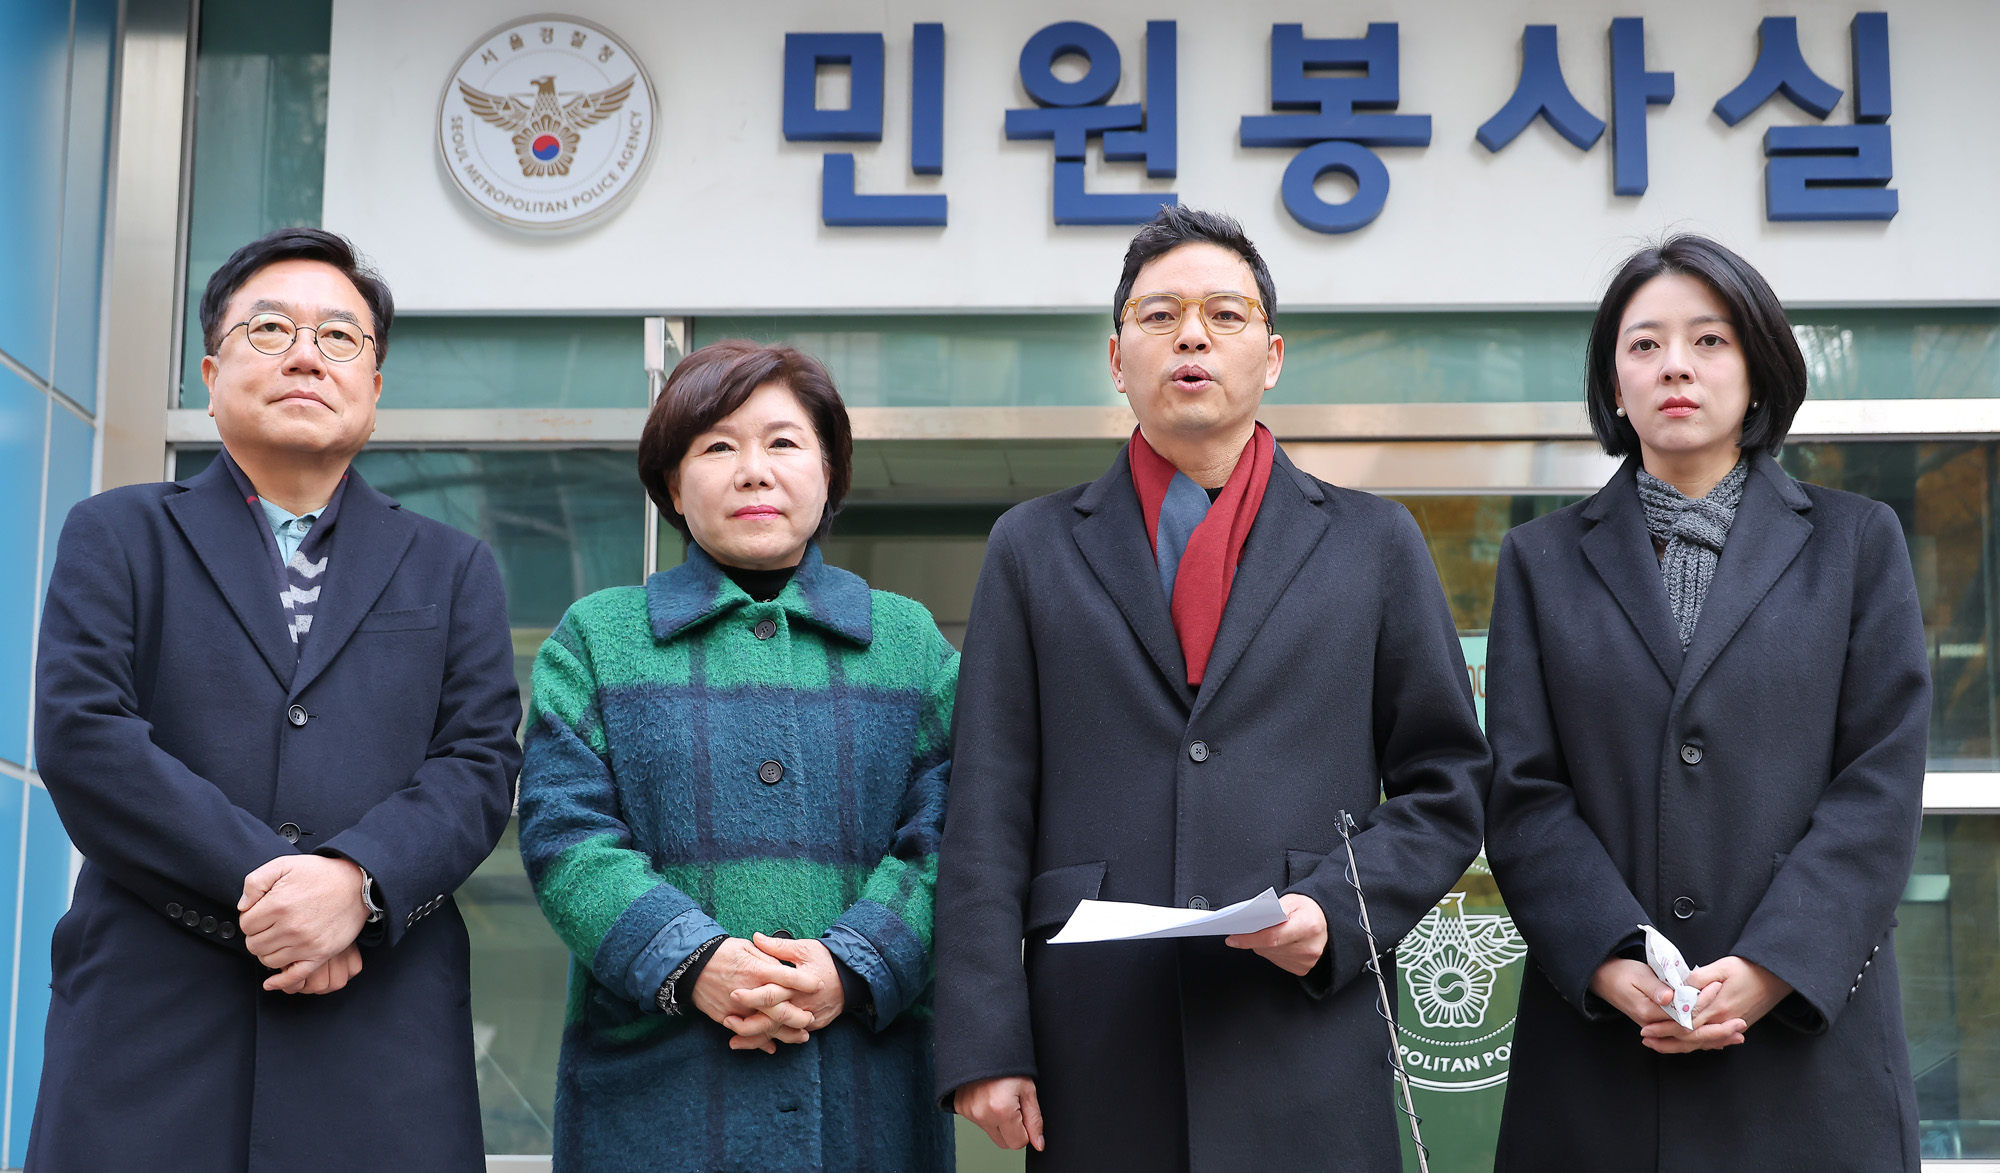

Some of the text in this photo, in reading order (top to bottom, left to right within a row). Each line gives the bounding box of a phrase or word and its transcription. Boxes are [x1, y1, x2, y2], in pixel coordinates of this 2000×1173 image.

[481, 27, 615, 66] 서울경찰청
[451, 109, 643, 215] SEOUL METROPOLITAN POLICE AGENCY
[783, 11, 1899, 234] 민원봉사실
